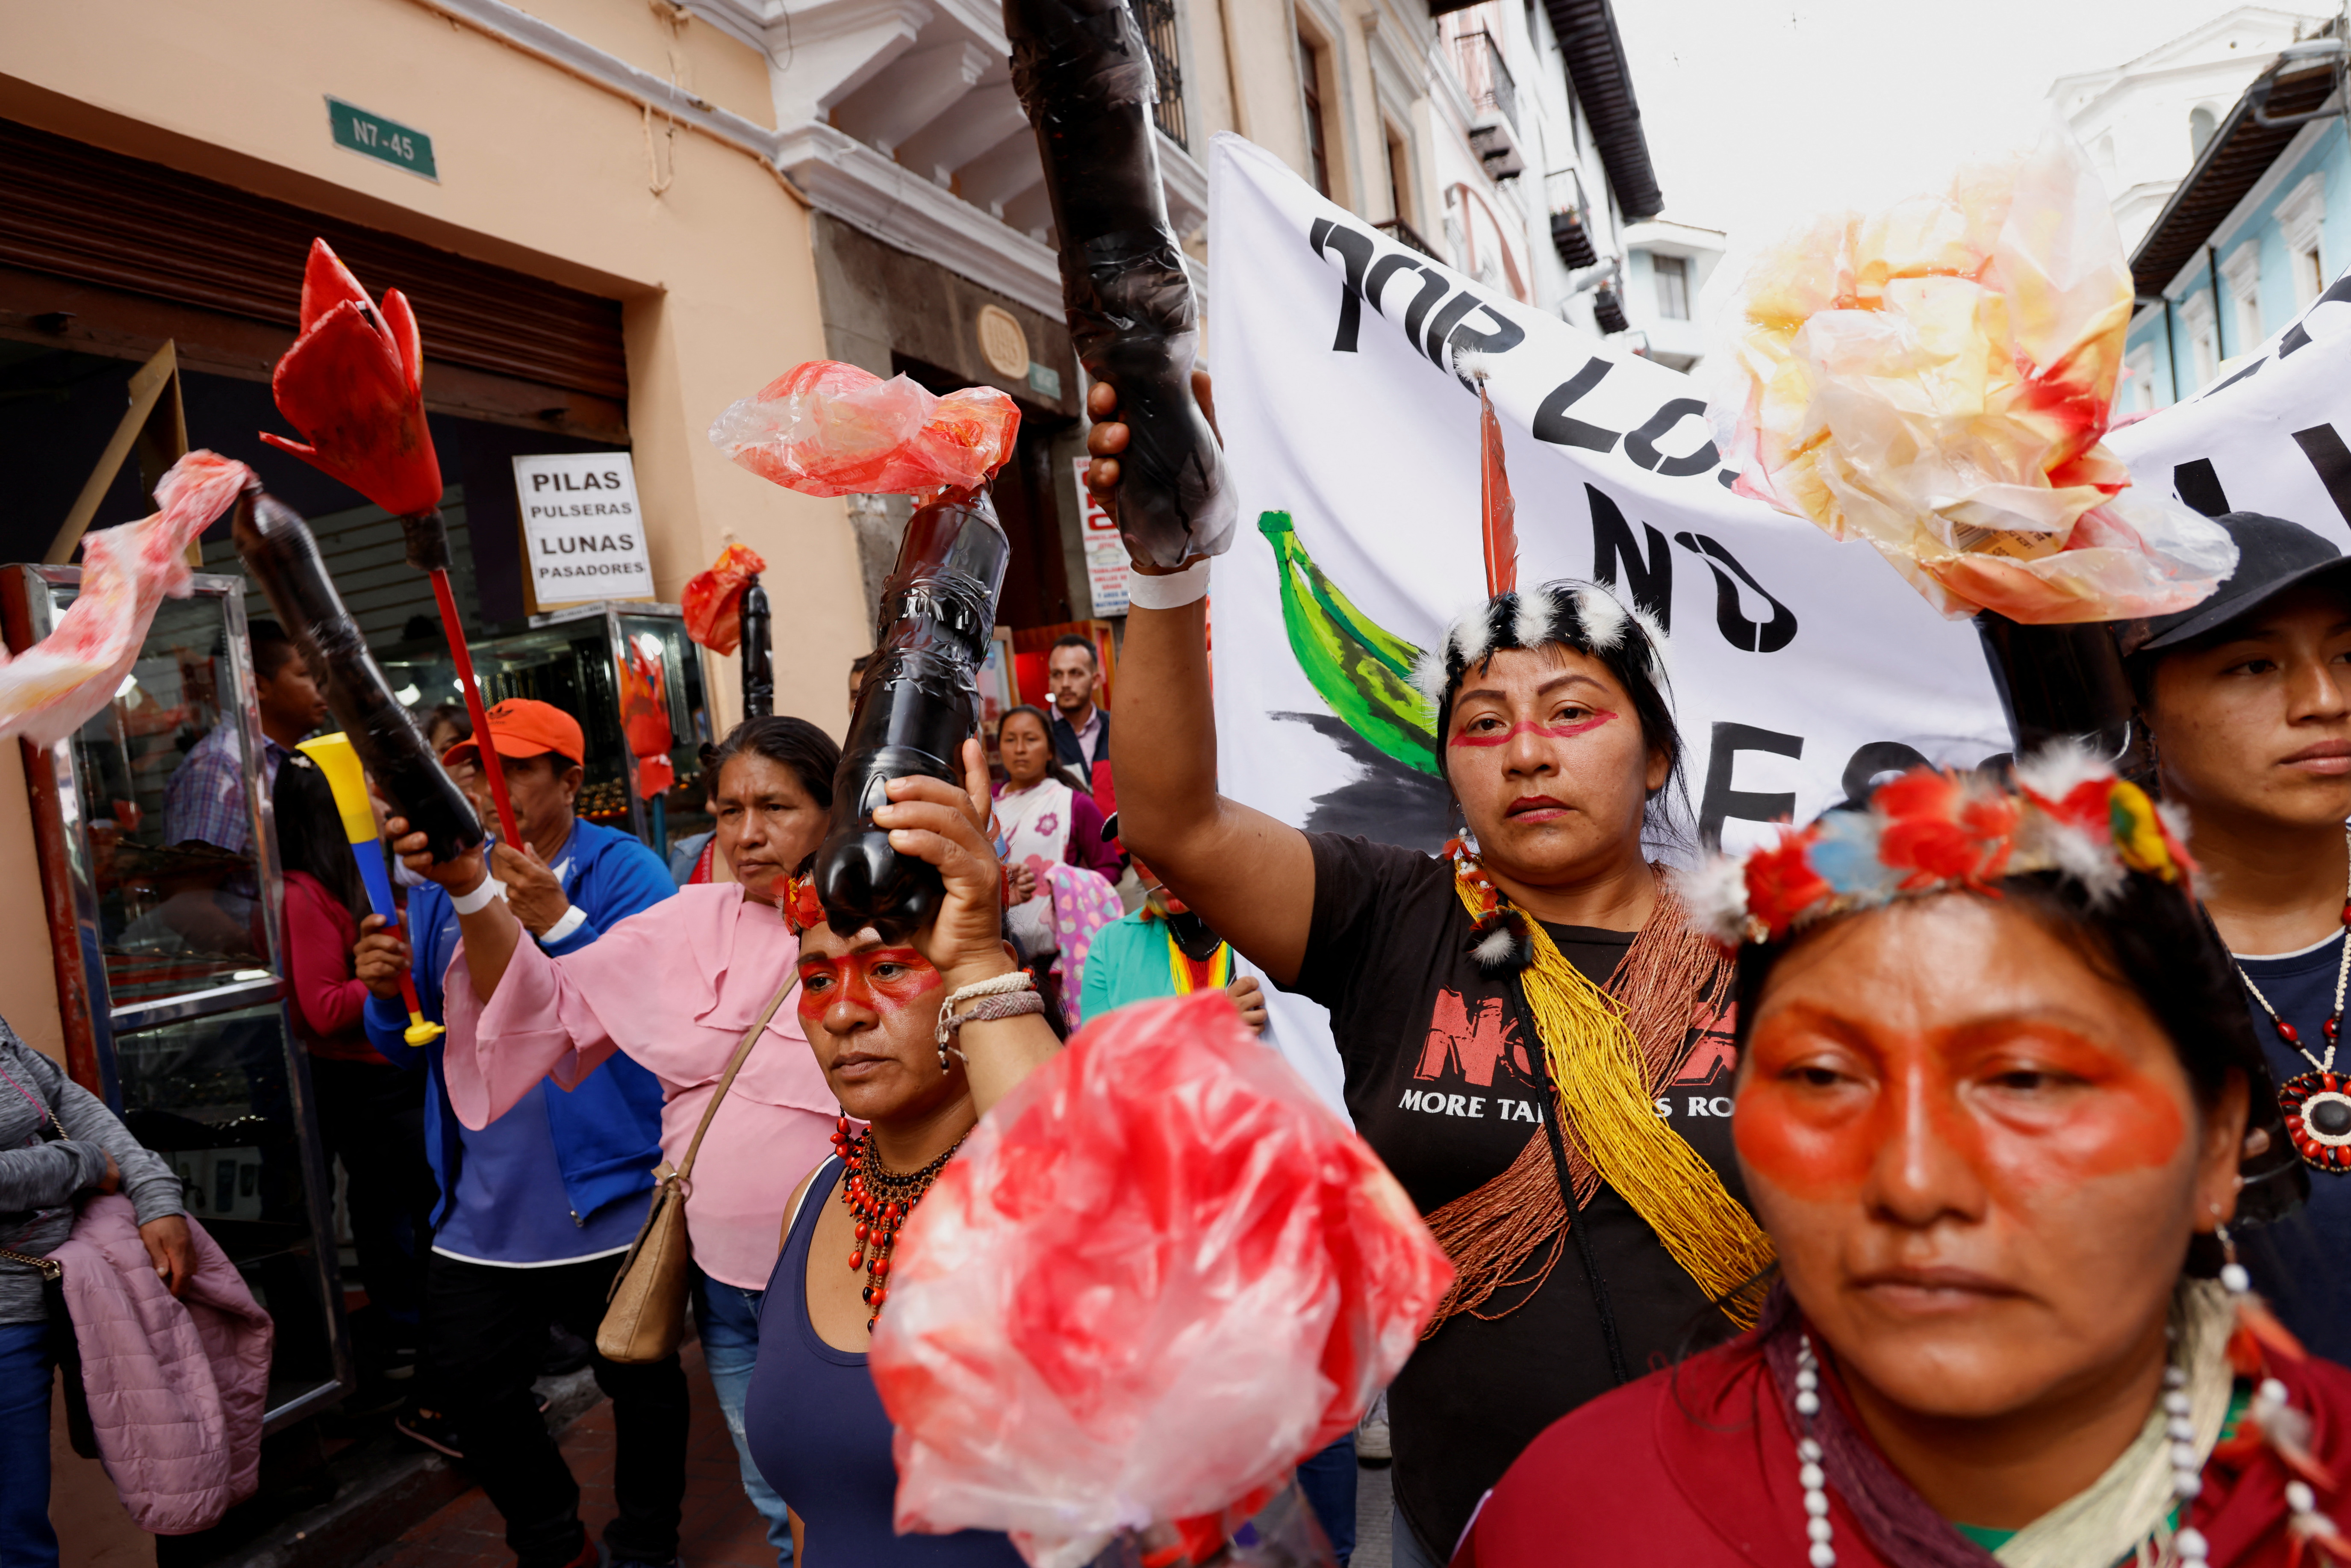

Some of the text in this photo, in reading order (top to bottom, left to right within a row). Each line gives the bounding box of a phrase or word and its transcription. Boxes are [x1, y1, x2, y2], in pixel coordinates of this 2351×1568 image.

[1532, 356, 1741, 490] LO
[532, 471, 621, 492] PILAS
[530, 502, 632, 518] PULSERAS
[540, 534, 634, 554] LUNAS
[539, 562, 644, 578] PASADORES
[1583, 482, 1798, 653] NO
[1398, 1089, 1487, 1118] MORE
